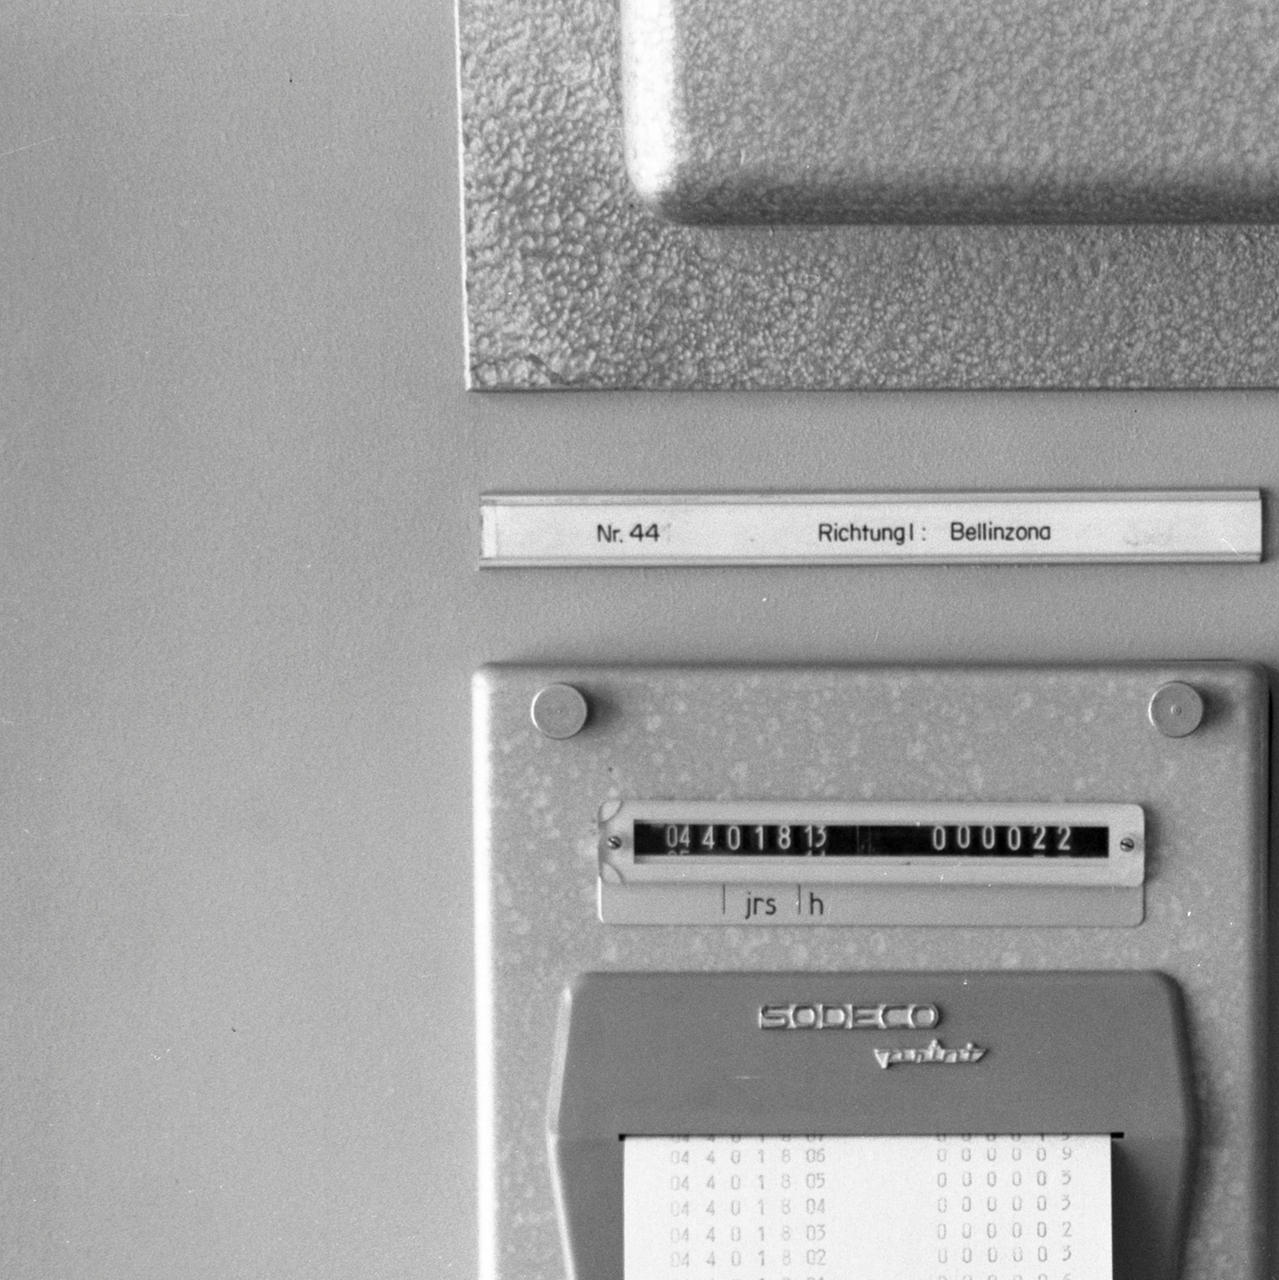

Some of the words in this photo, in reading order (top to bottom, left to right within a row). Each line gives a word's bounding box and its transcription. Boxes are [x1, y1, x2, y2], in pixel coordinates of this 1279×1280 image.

[949, 521, 1053, 542] Bellinzona
[744, 891, 777, 920] jrs
[808, 891, 825, 915] h
[757, 1002, 943, 1030] SODECO
